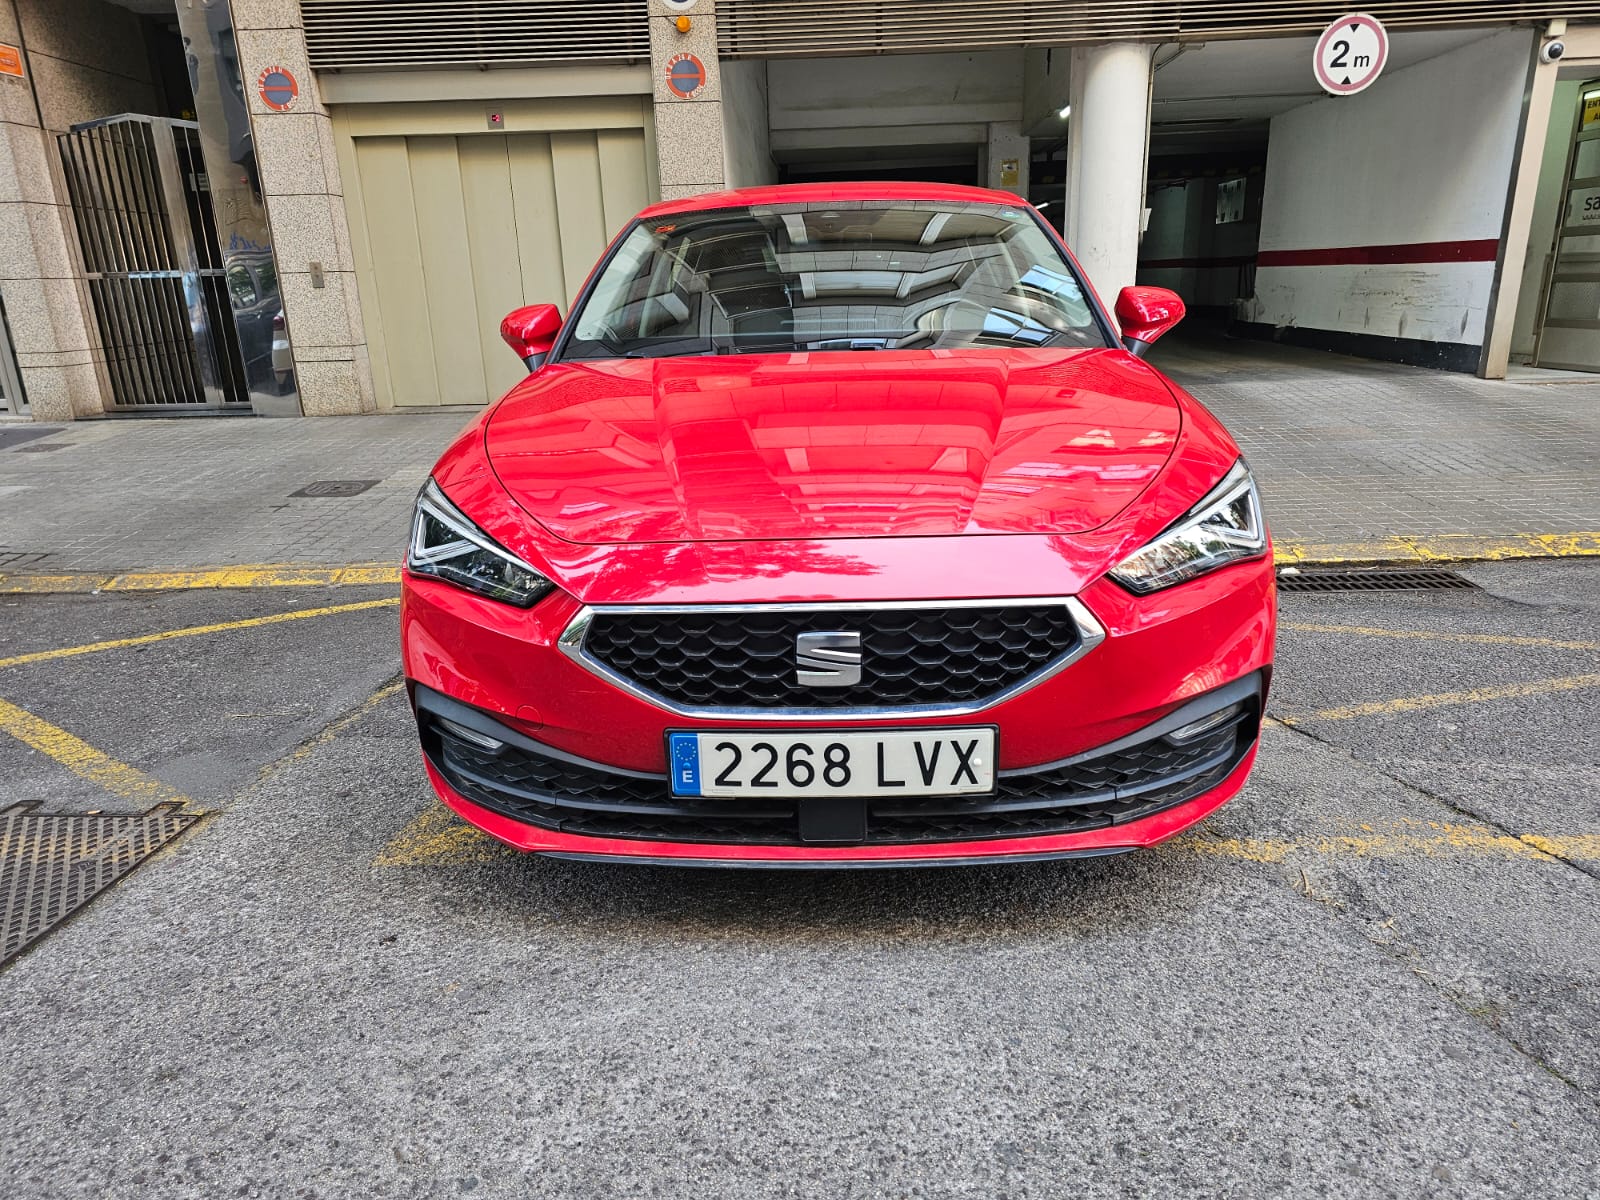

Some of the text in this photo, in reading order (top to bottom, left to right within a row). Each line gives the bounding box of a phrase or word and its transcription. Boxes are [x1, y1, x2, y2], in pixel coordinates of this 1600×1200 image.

[1330, 40, 1370, 68] 2 m
[682, 770, 693, 783] E
[714, 739, 979, 787] 2268 LVX
